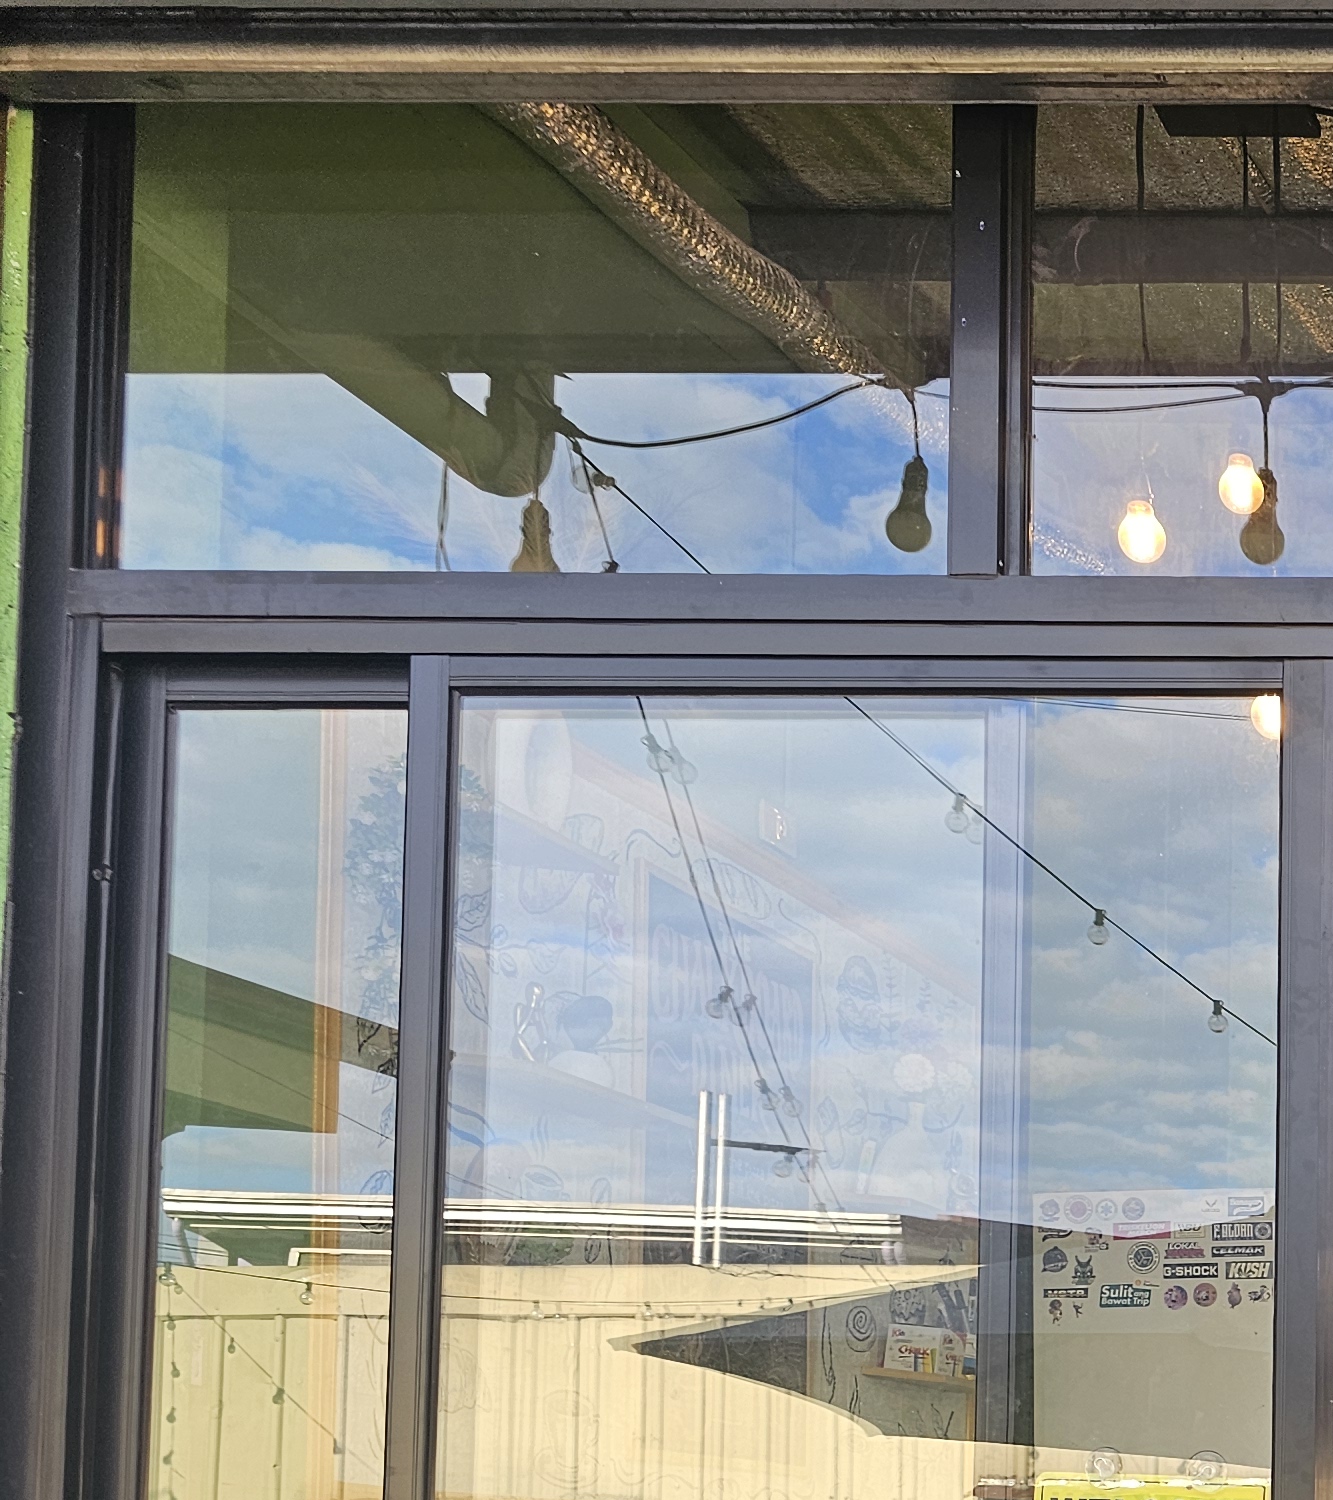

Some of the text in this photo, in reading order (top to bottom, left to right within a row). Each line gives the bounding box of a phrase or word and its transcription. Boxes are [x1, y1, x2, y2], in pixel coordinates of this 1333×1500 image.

[1164, 1266, 1218, 1277] G-SHOCK
[1229, 1262, 1270, 1278] KUSH
[1101, 1285, 1133, 1297] Sulit
[1133, 1297, 1150, 1306] Trip
